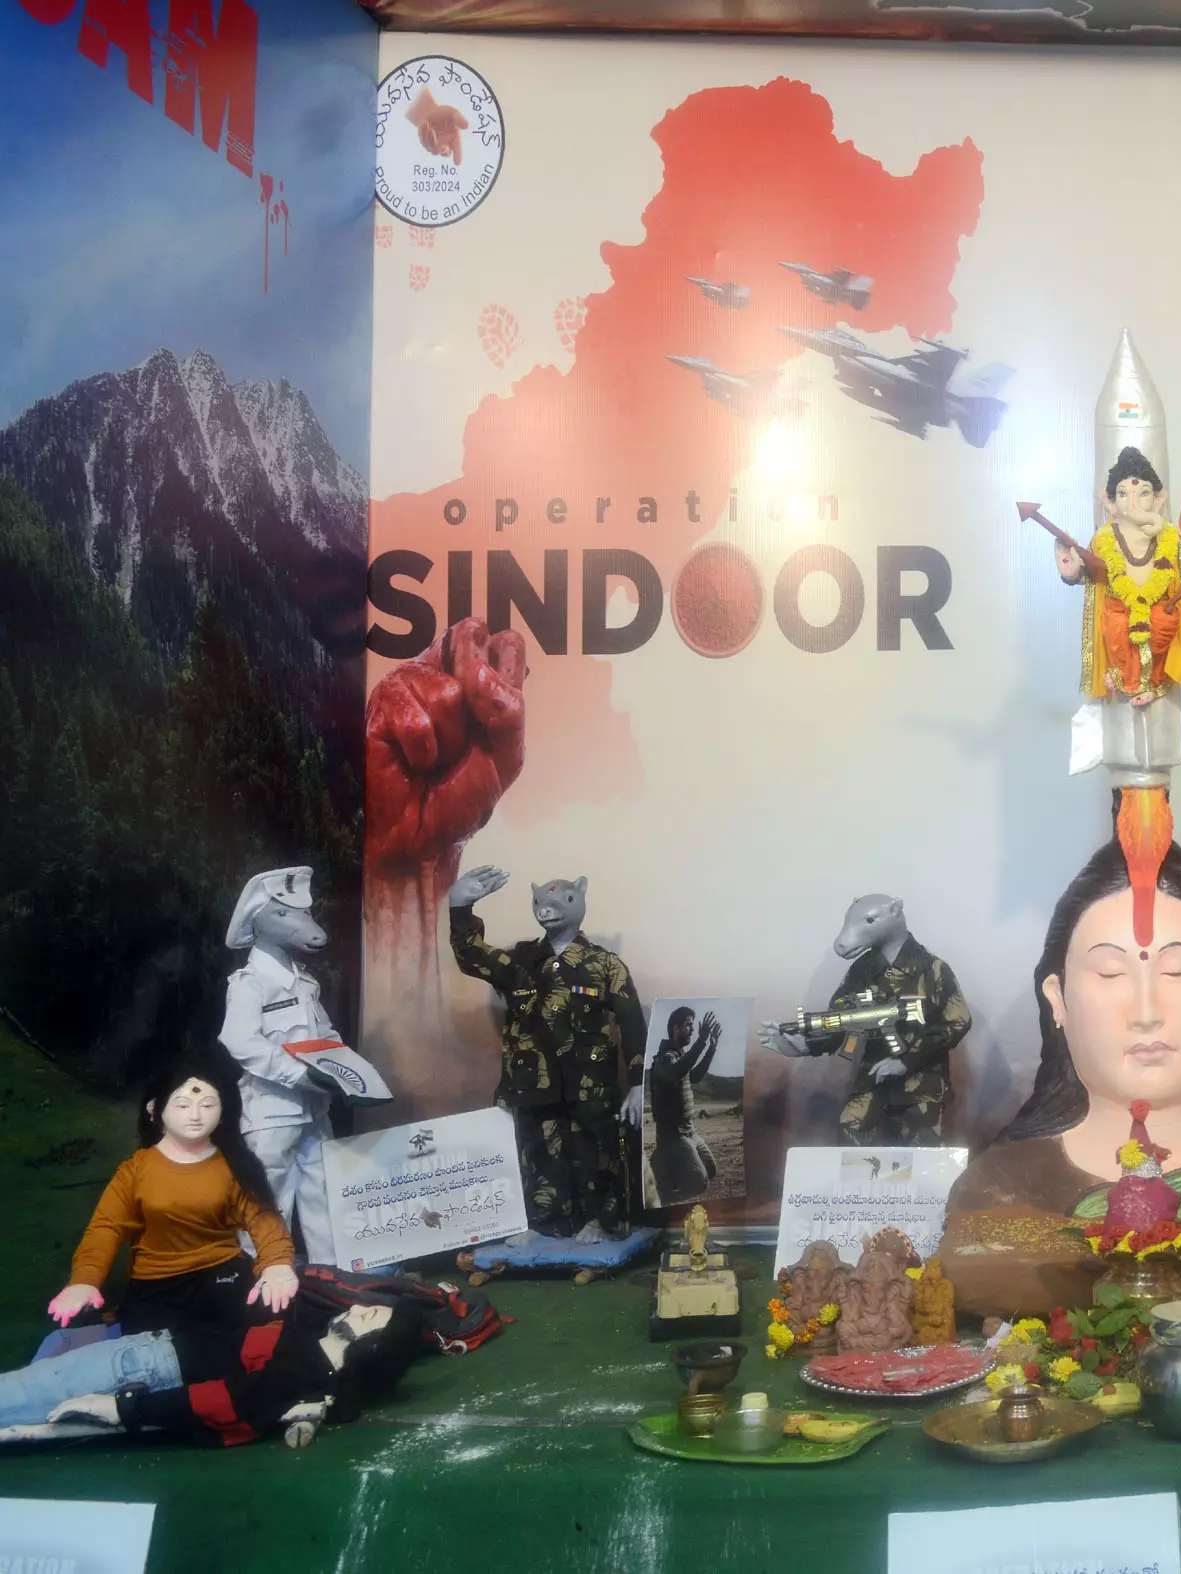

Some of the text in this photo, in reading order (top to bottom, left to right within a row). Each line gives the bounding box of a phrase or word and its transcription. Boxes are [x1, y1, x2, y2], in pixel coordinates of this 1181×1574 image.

[413, 164, 459, 178] Reg. No.
[375, 163, 494, 220] Proud to be an Indian
[412, 181, 460, 192] 303/2024
